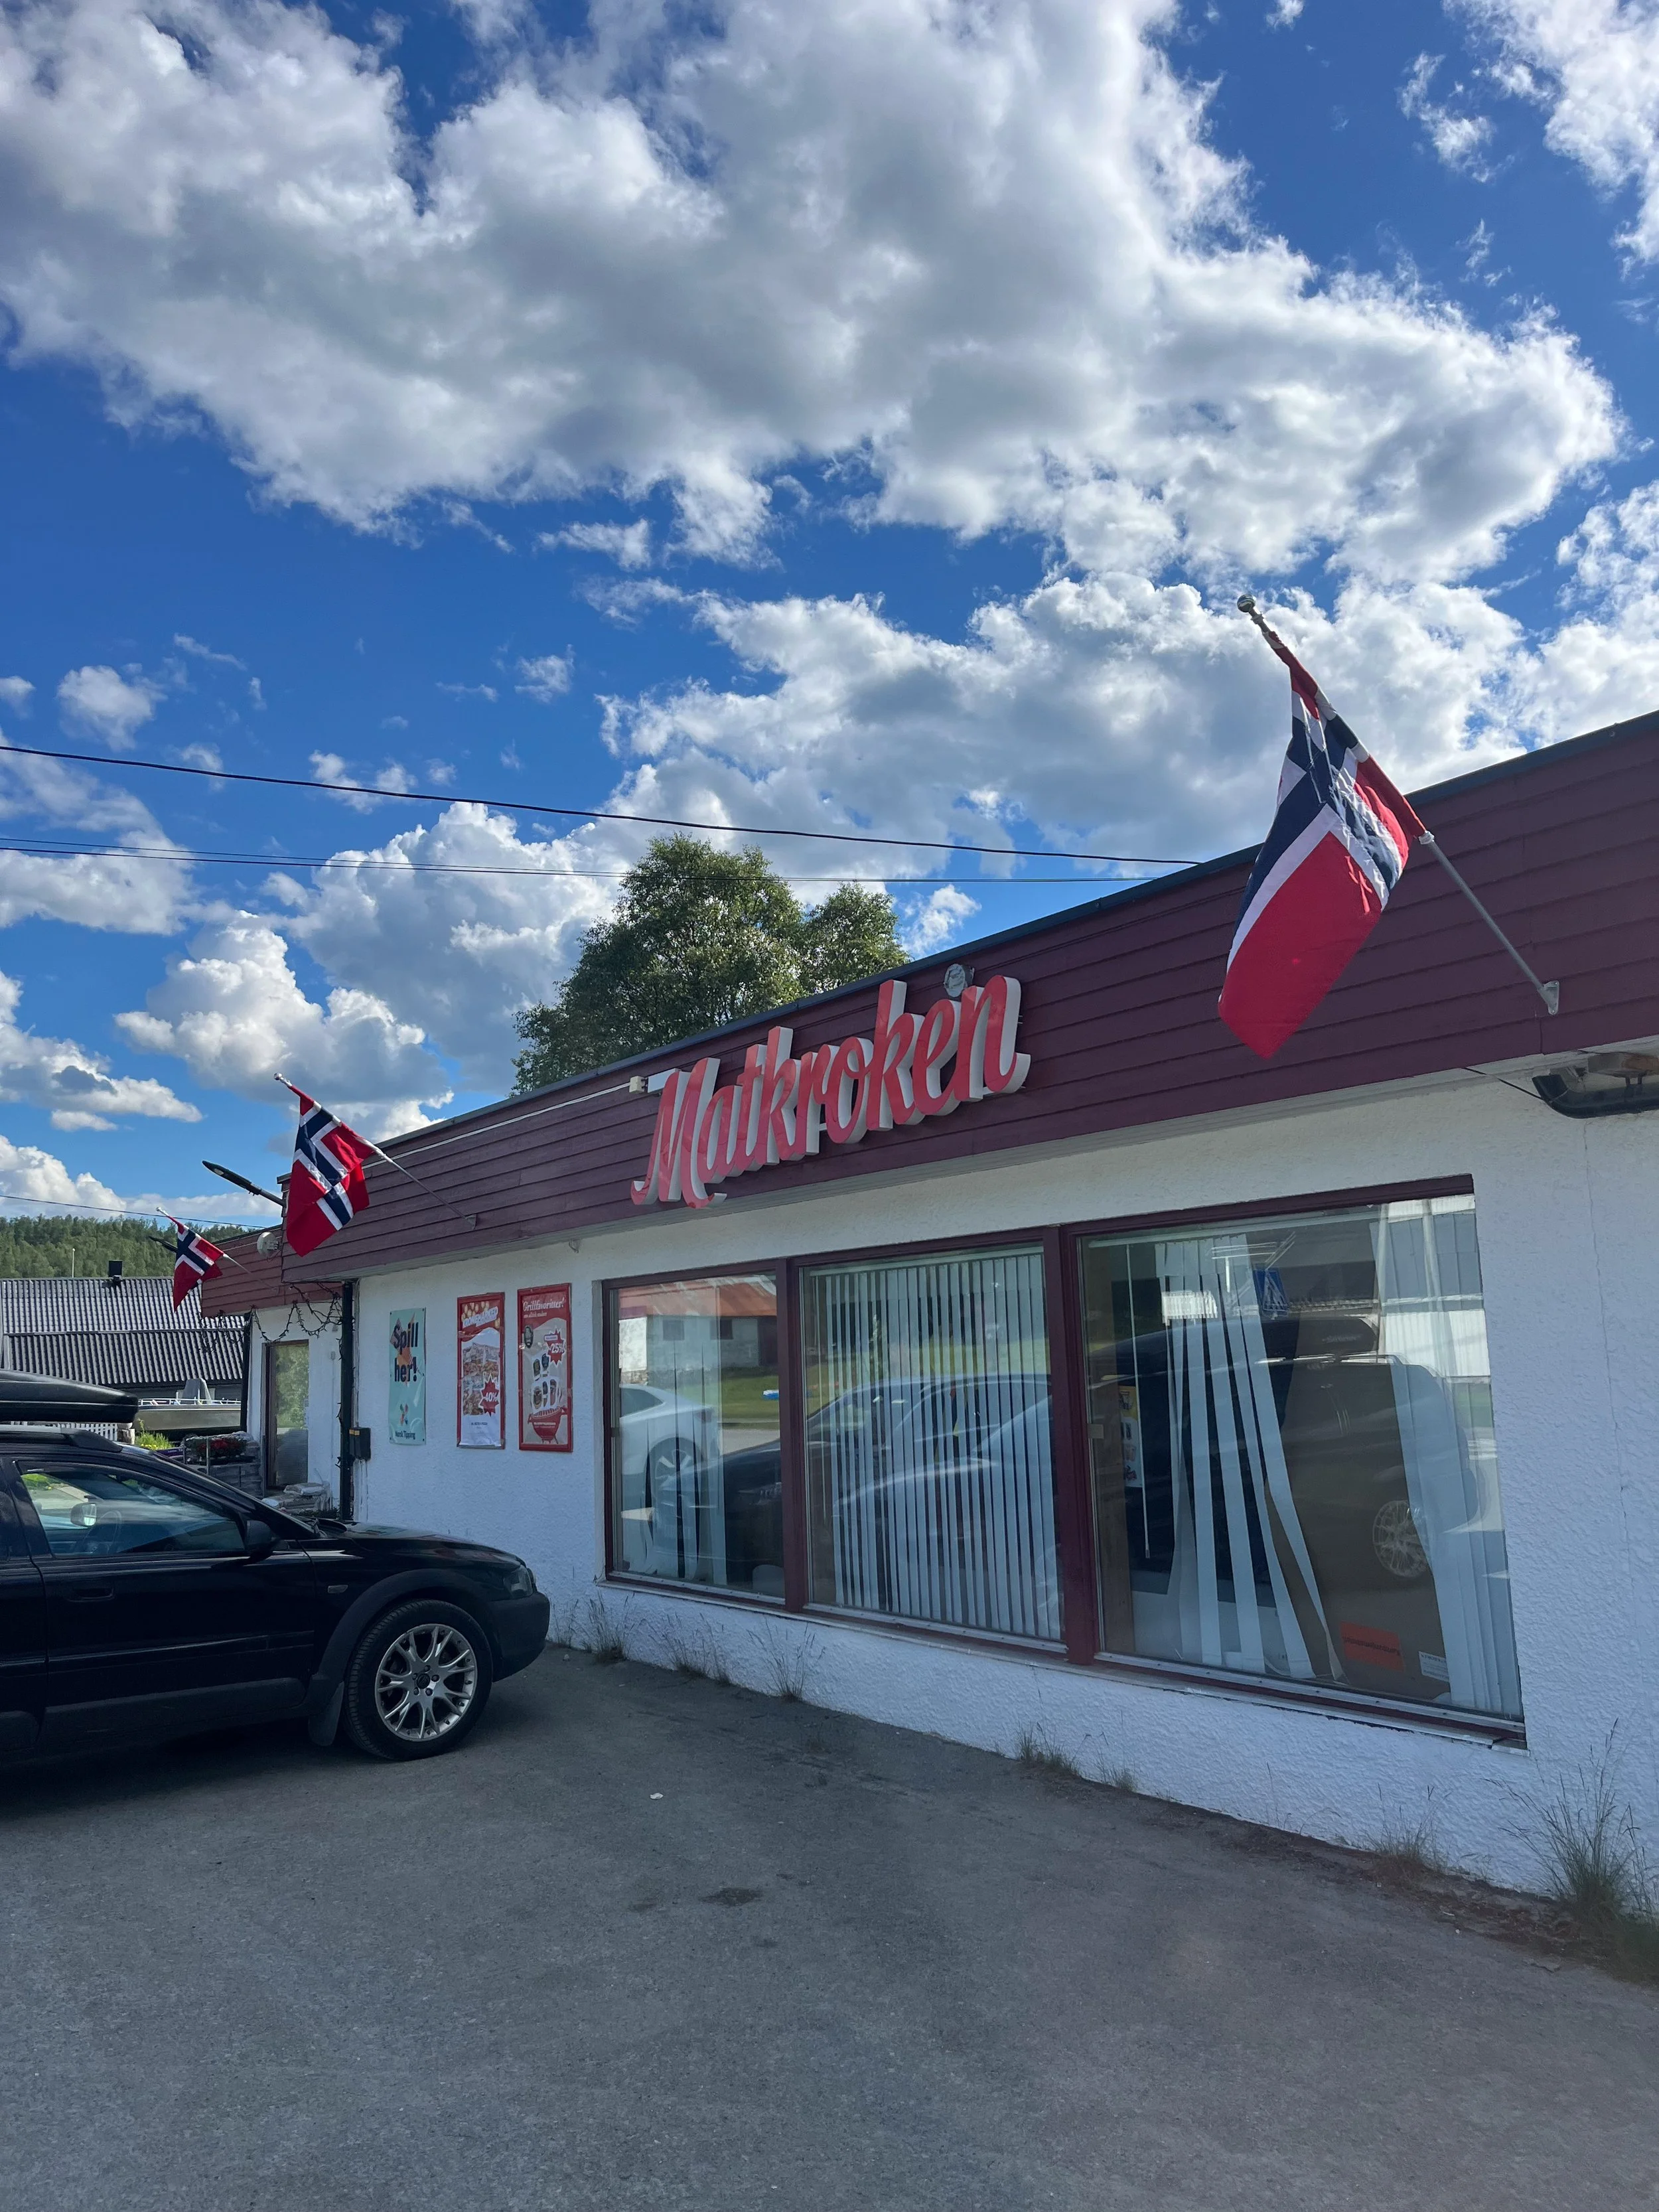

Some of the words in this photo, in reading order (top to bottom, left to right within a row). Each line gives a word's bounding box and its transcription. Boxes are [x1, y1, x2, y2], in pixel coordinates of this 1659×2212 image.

[631, 975, 1031, 1209] Matkroken
[393, 1321, 419, 1355] Spill
[394, 1357, 417, 1382] her!
